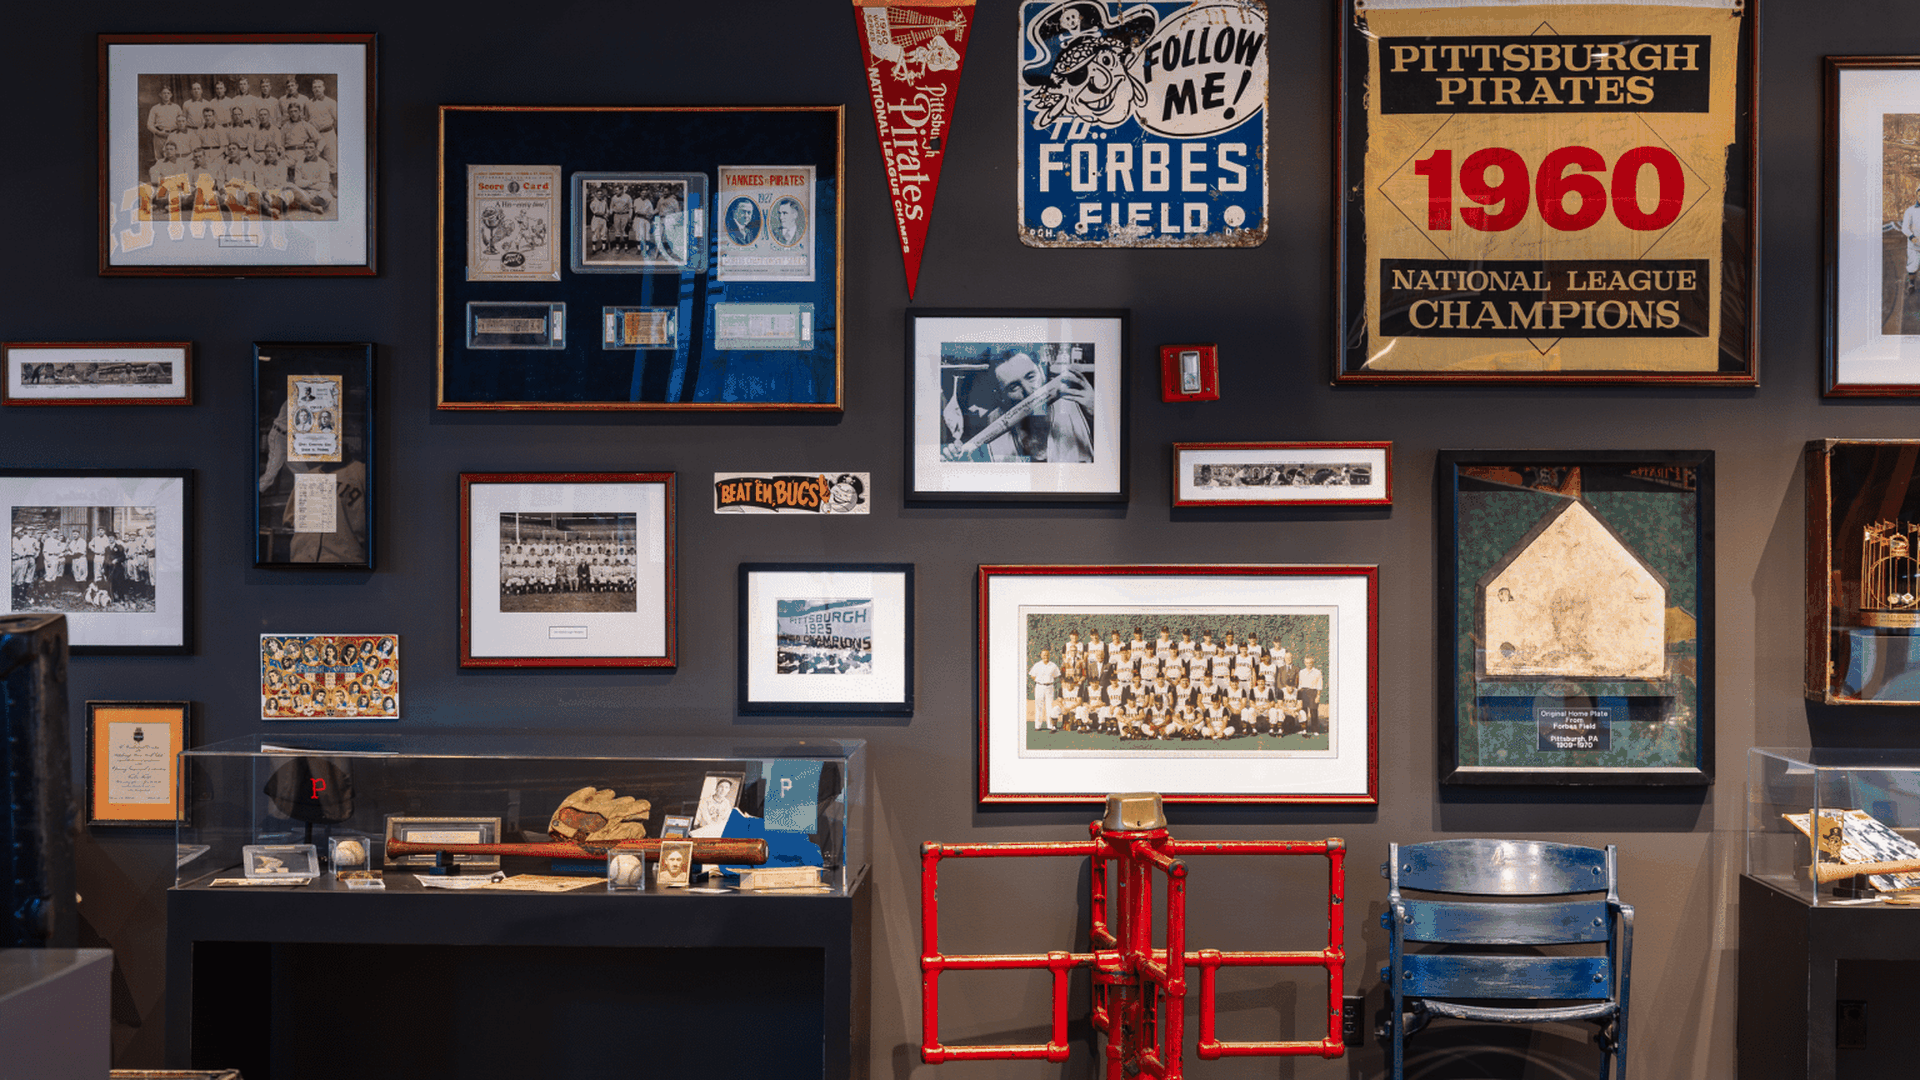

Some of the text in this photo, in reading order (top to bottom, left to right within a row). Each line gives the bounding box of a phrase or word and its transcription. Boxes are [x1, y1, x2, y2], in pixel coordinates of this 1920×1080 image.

[1143, 26, 1264, 84] FOLLOW
[1390, 43, 1700, 73] PITTSBURGH
[1162, 69, 1252, 122] ME!
[1436, 76, 1655, 106] PIRATES
[868, 67, 910, 254] NATIONAL LEAGUE CHAMPS
[887, 92, 932, 221] Pirates
[1039, 143, 1247, 193] FORBES
[478, 182, 549, 191] Score Card
[725, 174, 764, 186] YANKEES
[769, 174, 805, 187] PIRATES
[1414, 145, 1686, 232] 1960
[1075, 202, 1209, 234] FIELD
[1392, 269, 1697, 292] NATIONAL LEAGUE
[1408, 300, 1680, 330] CHAMPIONS
[789, 609, 867, 624] PITTSBURGH
[804, 623, 832, 635] 1925
[1540, 710, 1567, 718] Original
[310, 777, 327, 799] P
[779, 777, 793, 798] P
